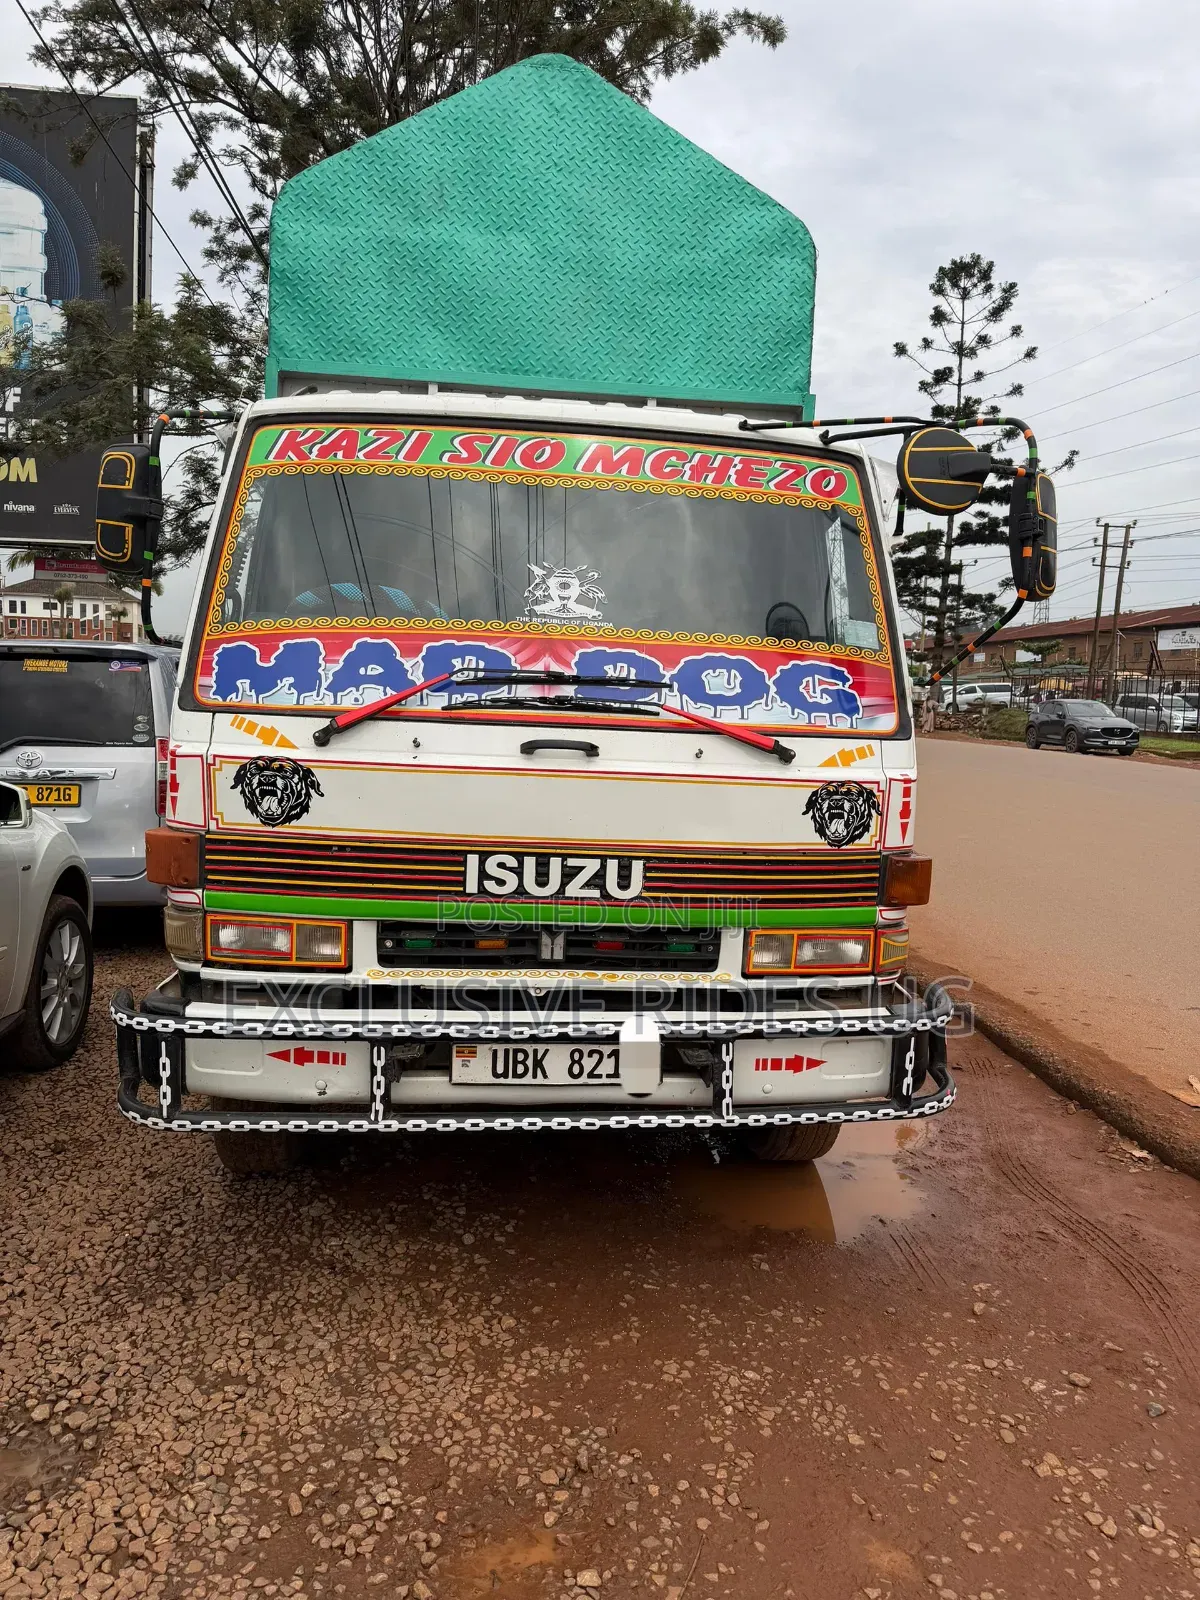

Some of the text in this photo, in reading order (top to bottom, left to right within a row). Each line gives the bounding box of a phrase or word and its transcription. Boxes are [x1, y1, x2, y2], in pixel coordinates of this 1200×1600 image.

[265, 427, 848, 500] KAZI SIO MCHEZO
[3, 500, 35, 512] nivana
[533, 617, 569, 625] REPUBLIC
[210, 637, 863, 729] MAD DOG
[36, 786, 72, 802] 871G
[465, 853, 645, 900] ISUZU
[491, 1047, 549, 1080] UBK
